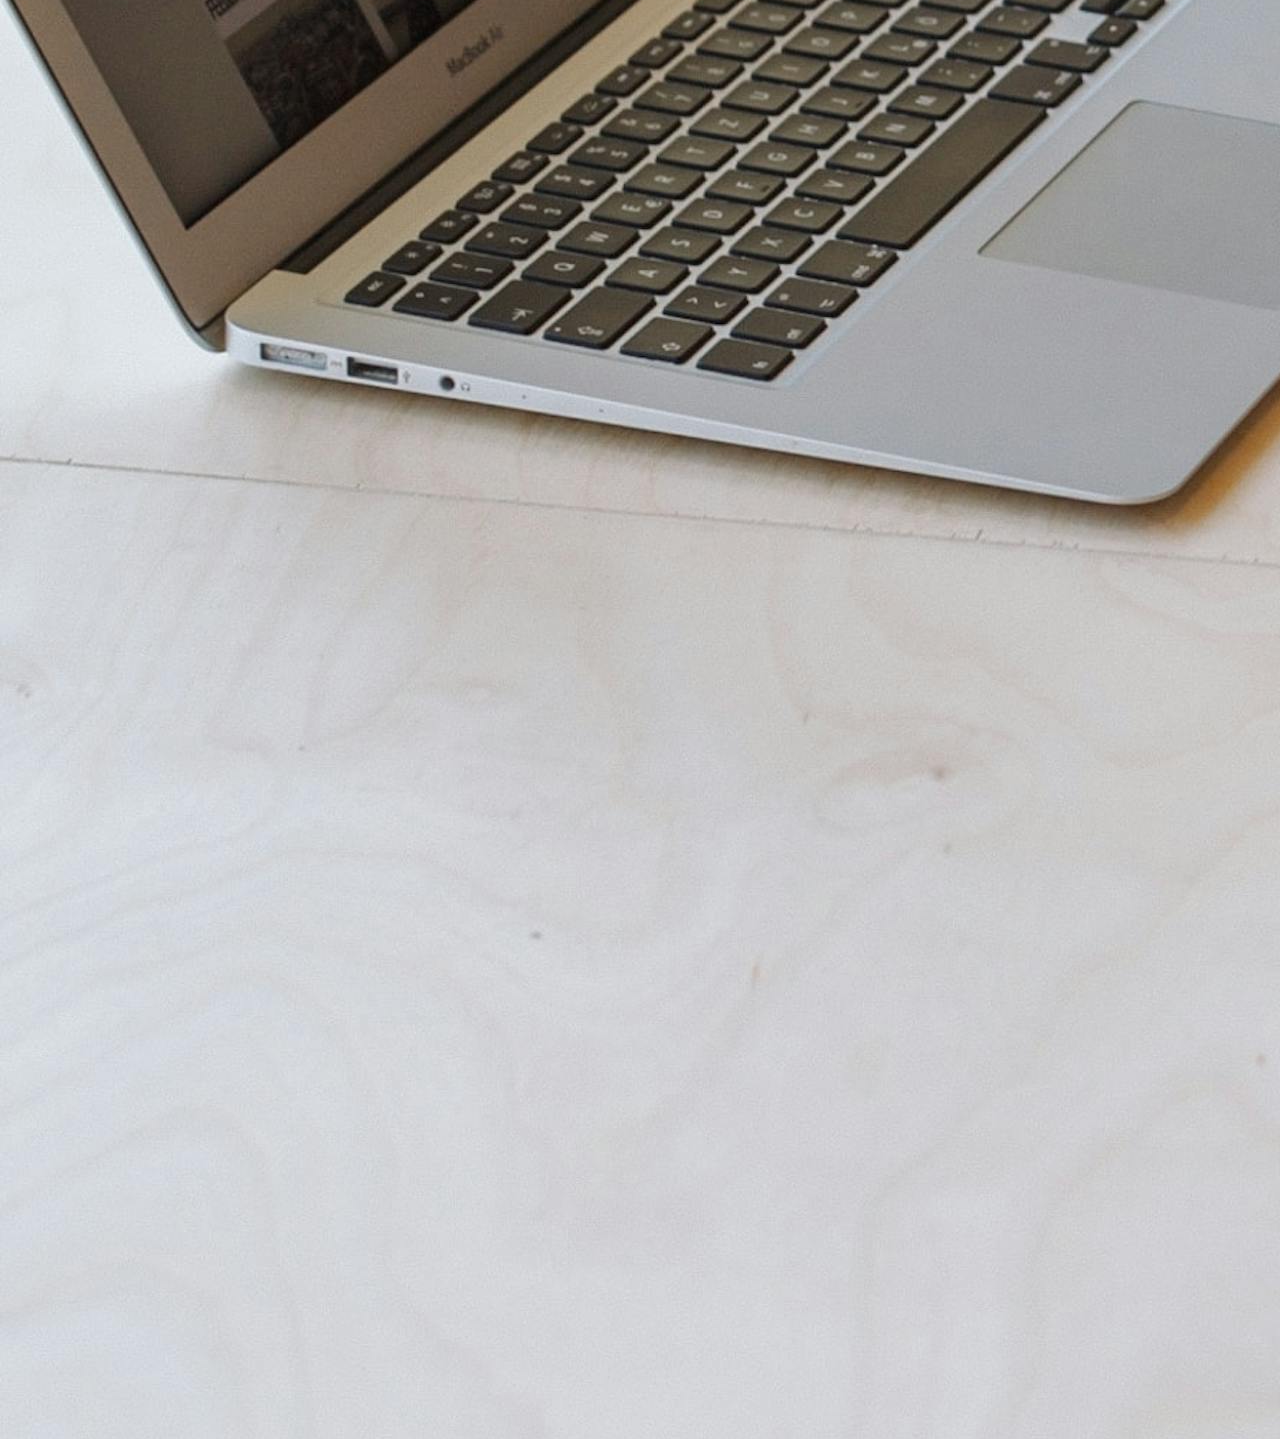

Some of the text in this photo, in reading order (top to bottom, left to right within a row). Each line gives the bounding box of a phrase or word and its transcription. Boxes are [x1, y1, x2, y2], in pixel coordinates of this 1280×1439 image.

[445, 33, 491, 79] MacBook
[554, 263, 575, 271] Q
[586, 231, 609, 242] W
[621, 204, 641, 212] E
[654, 175, 674, 184] R
[719, 119, 739, 128] Z
[750, 91, 769, 101] U
[811, 38, 830, 47] O
[611, 150, 628, 158] 5
[638, 270, 657, 278] A
[671, 239, 690, 247] S
[703, 210, 723, 219] D
[736, 180, 754, 189] F
[768, 153, 787, 162] G
[798, 124, 818, 134] H
[861, 70, 879, 78] K
[762, 238, 782, 247] X
[794, 209, 814, 218] C
[824, 180, 843, 188] V
[856, 152, 875, 161] B
[885, 124, 906, 133] N
[915, 96, 936, 106] M
